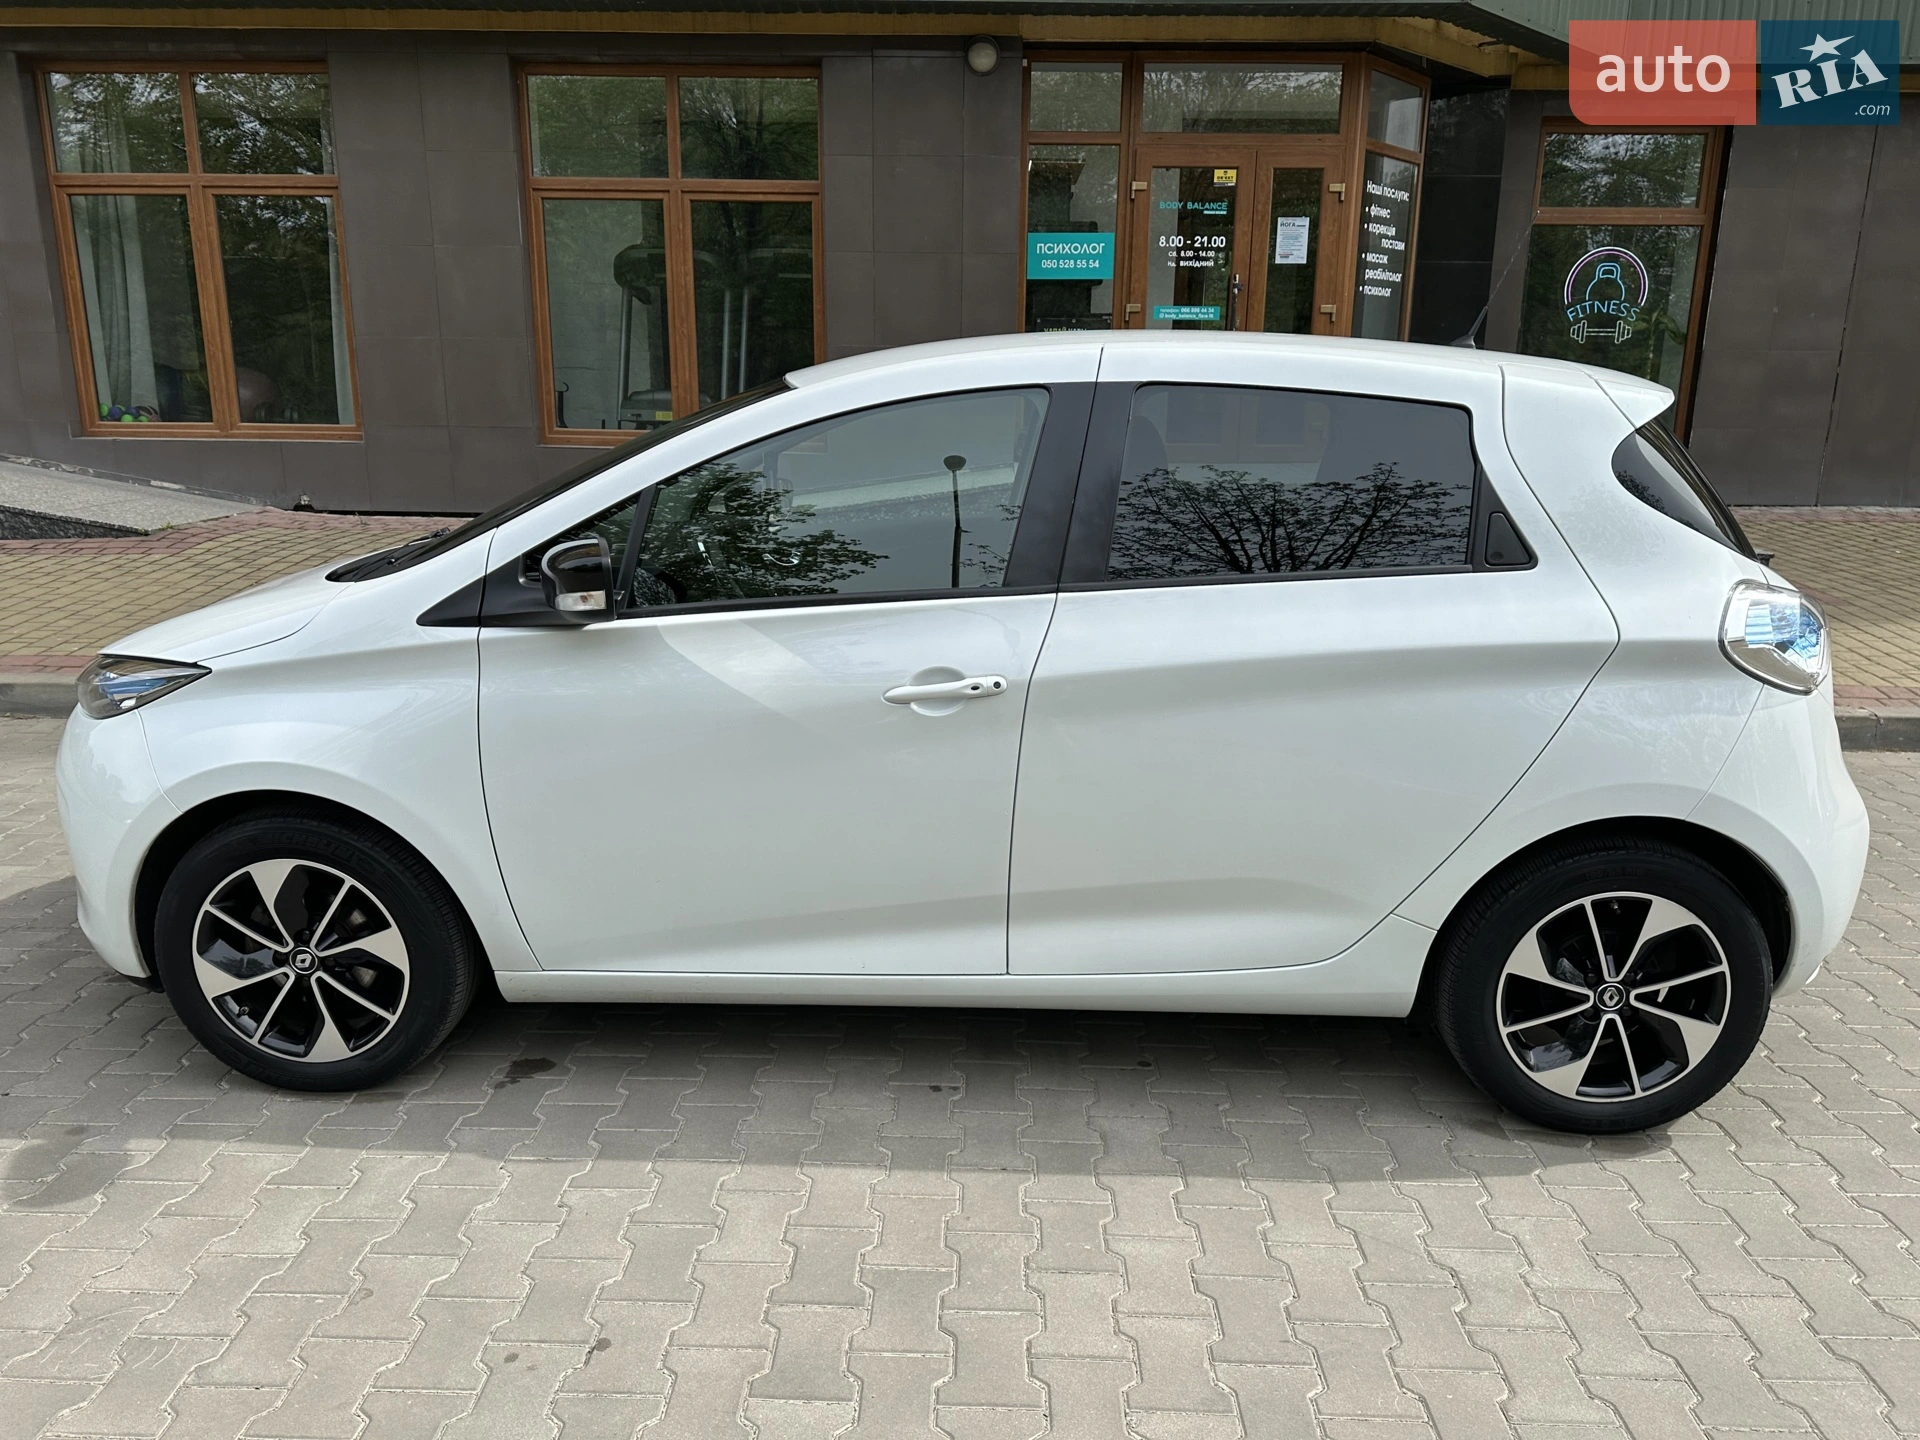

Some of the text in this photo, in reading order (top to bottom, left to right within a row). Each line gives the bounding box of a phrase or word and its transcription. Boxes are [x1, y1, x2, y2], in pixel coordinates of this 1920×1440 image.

[1366, 180, 1383, 196] Наші
[1159, 201, 1228, 210] BODY BALANCE
[1370, 203, 1391, 219] фітнес
[1159, 235, 1184, 247] 8.00
[1193, 235, 1226, 248] 21.00
[1036, 243, 1105, 254] ПСИХОЛОГ
[1198, 250, 1215, 258] 14.00
[1041, 259, 1100, 268] 050 528 55 54
[1566, 300, 1640, 322] FITNESS
